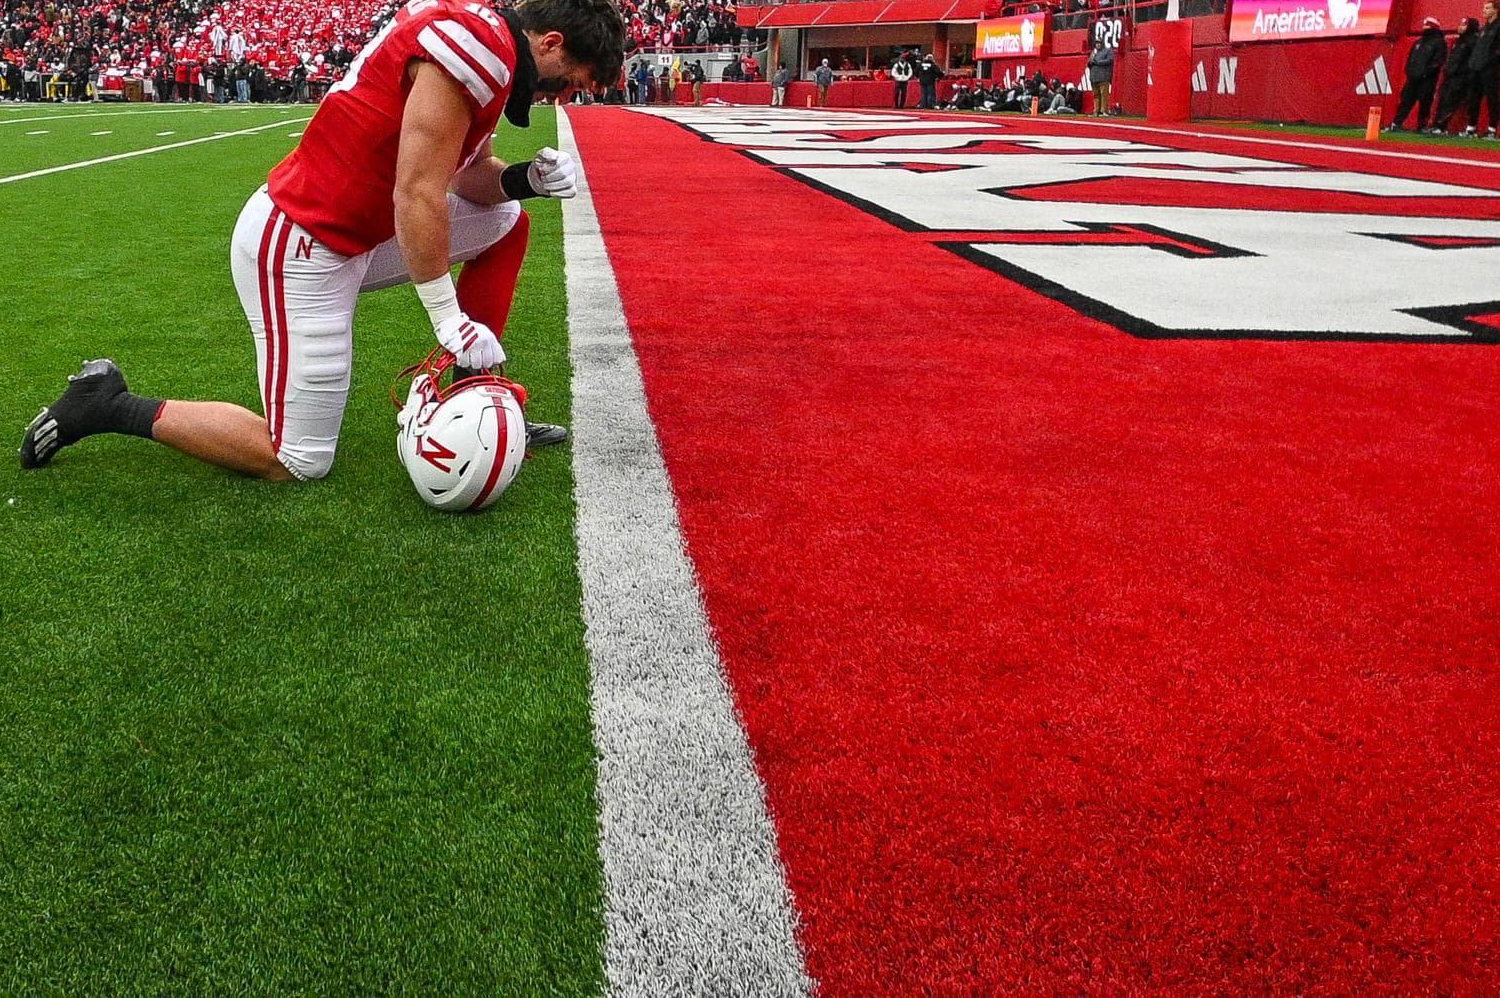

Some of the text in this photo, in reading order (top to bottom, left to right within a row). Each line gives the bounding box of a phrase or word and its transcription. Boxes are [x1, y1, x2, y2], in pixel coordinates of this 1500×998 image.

[1251, 6, 1326, 35] Ameritas
[983, 31, 1020, 53] Ameritas
[1217, 56, 1238, 95] N
[295, 235, 315, 260] N
[420, 435, 458, 474] N
